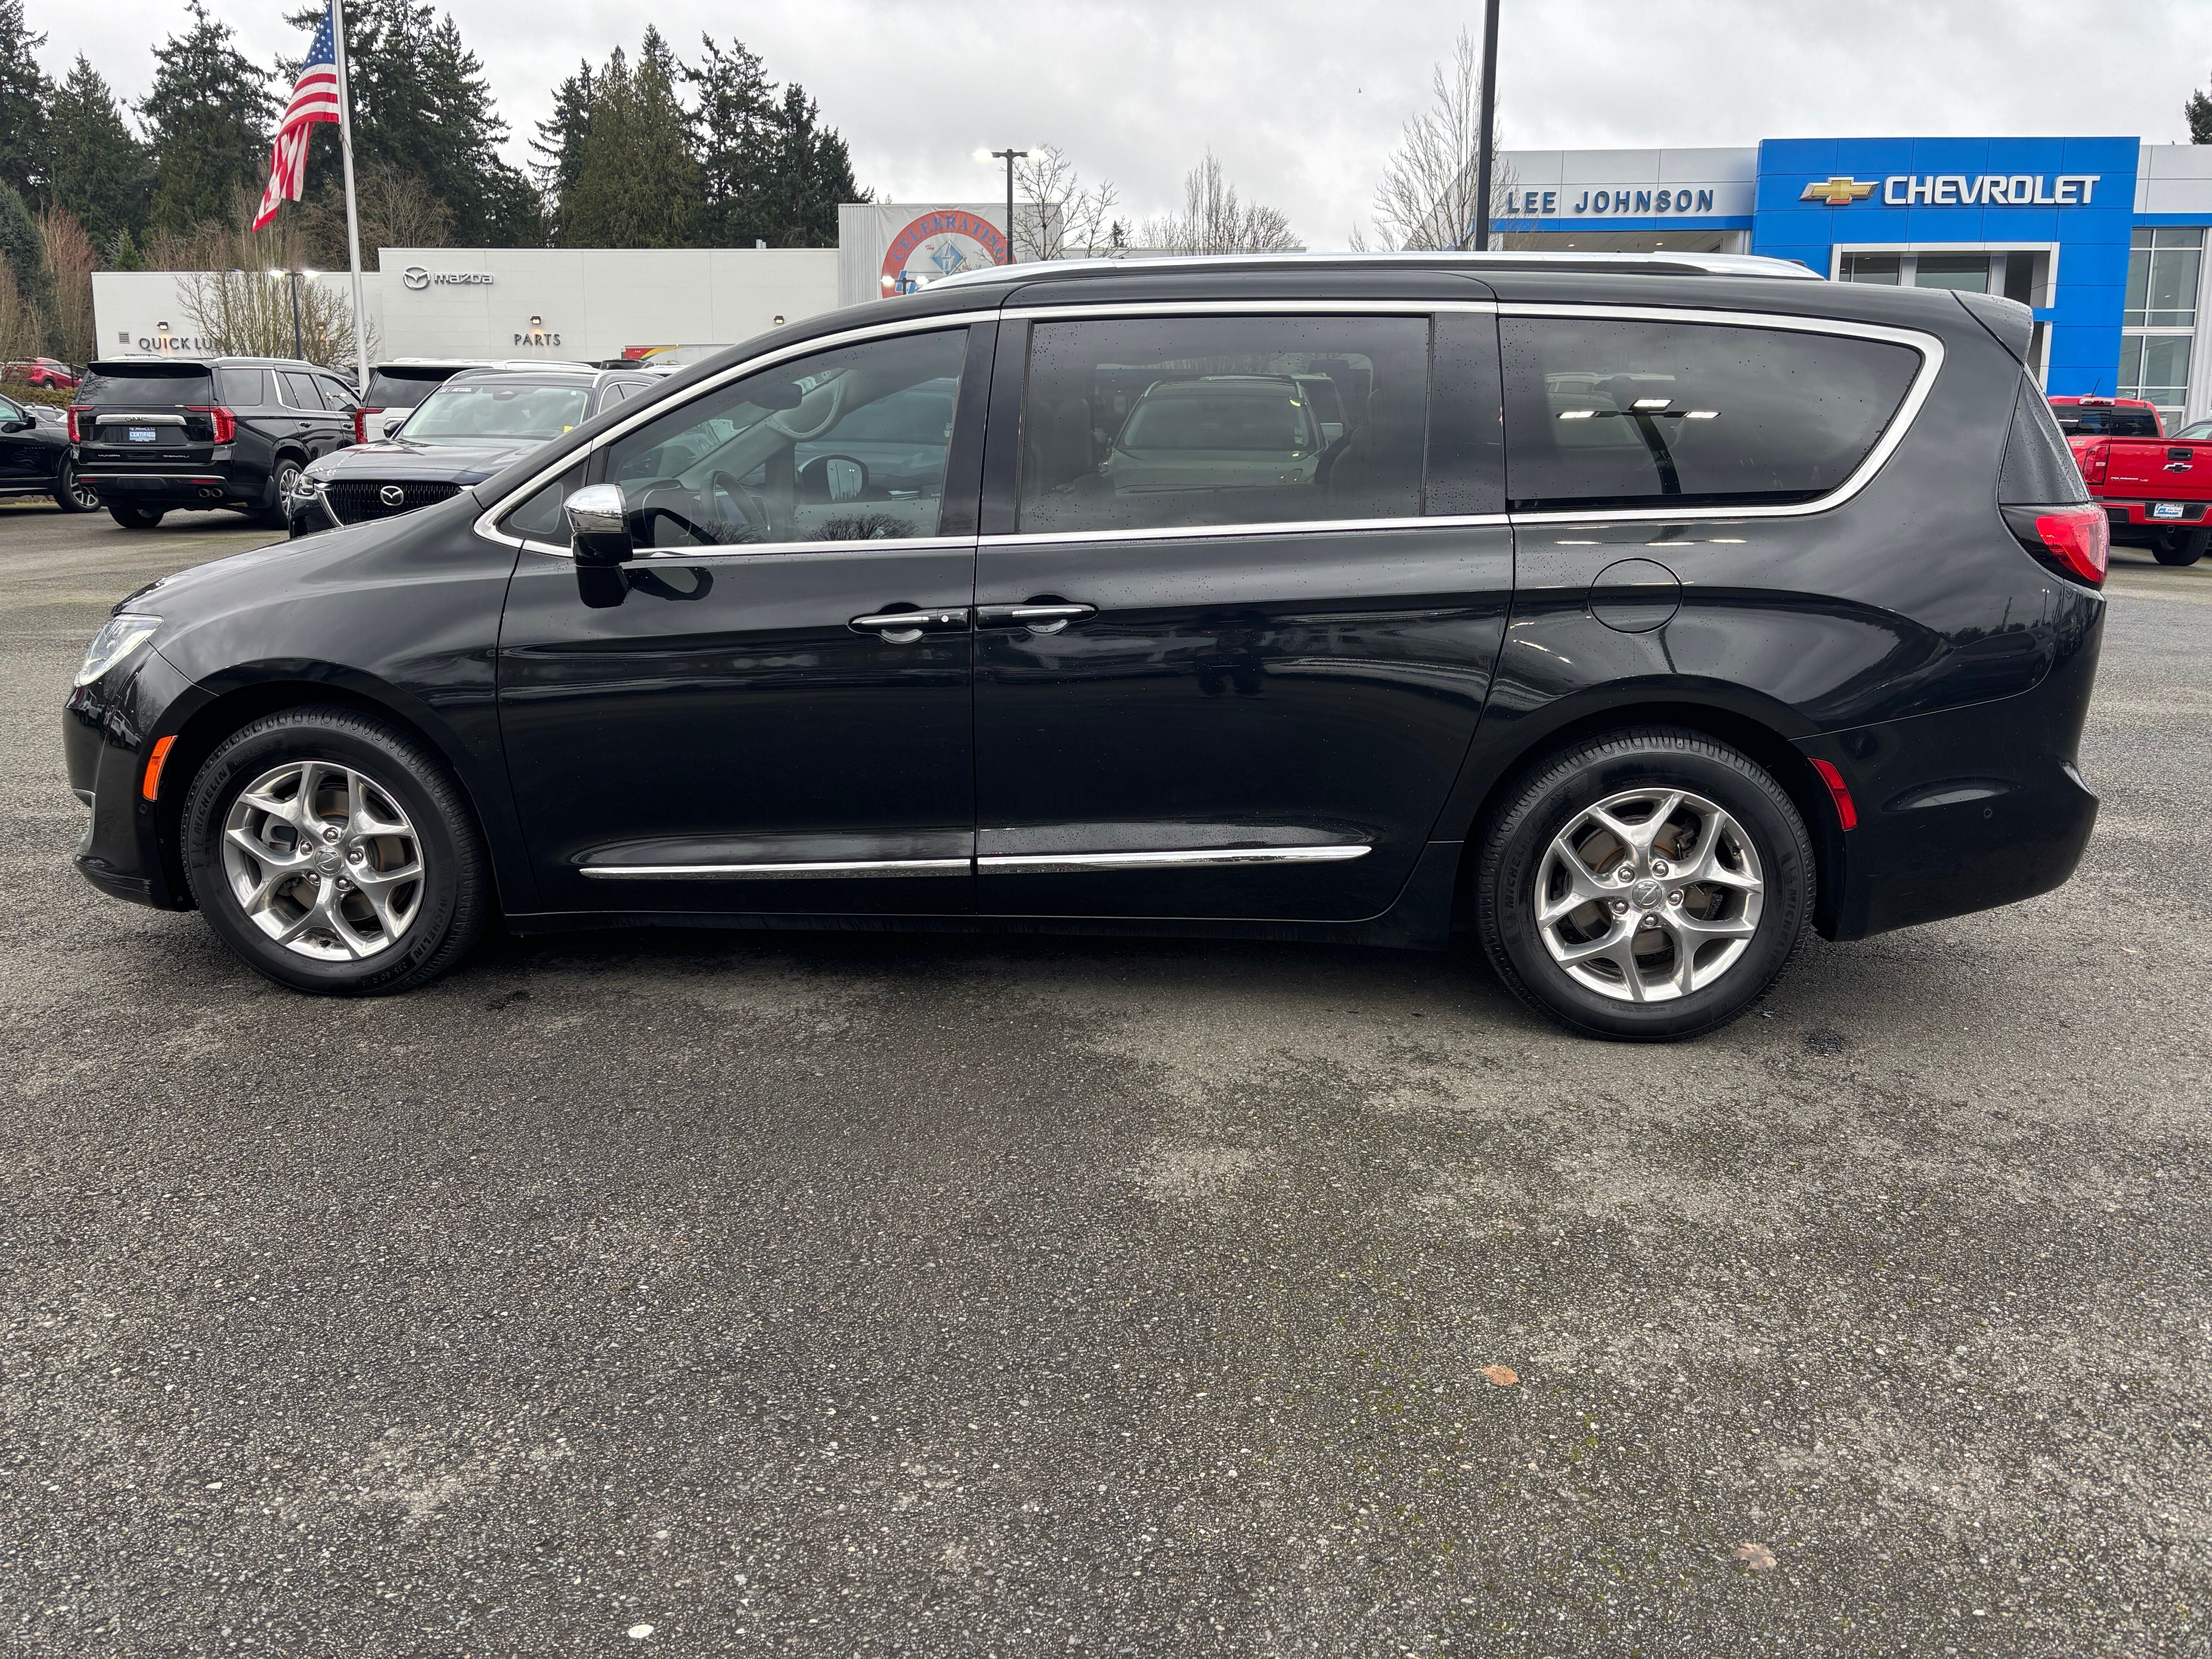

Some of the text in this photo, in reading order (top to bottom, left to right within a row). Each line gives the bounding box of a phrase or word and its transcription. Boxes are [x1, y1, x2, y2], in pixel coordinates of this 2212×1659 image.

[1508, 189, 1714, 213] LEE JOHNSON
[1884, 175, 2101, 204] CHEVROLET
[893, 216, 1006, 261] CELEBRATING
[139, 337, 191, 352] QUICK
[514, 333, 561, 346] PARTS
[194, 768, 228, 835] MICHELIN
[1505, 833, 1534, 909] MICHELIN
[413, 895, 447, 959] MICHELIN
[1767, 888, 1797, 965] MICHELIN
